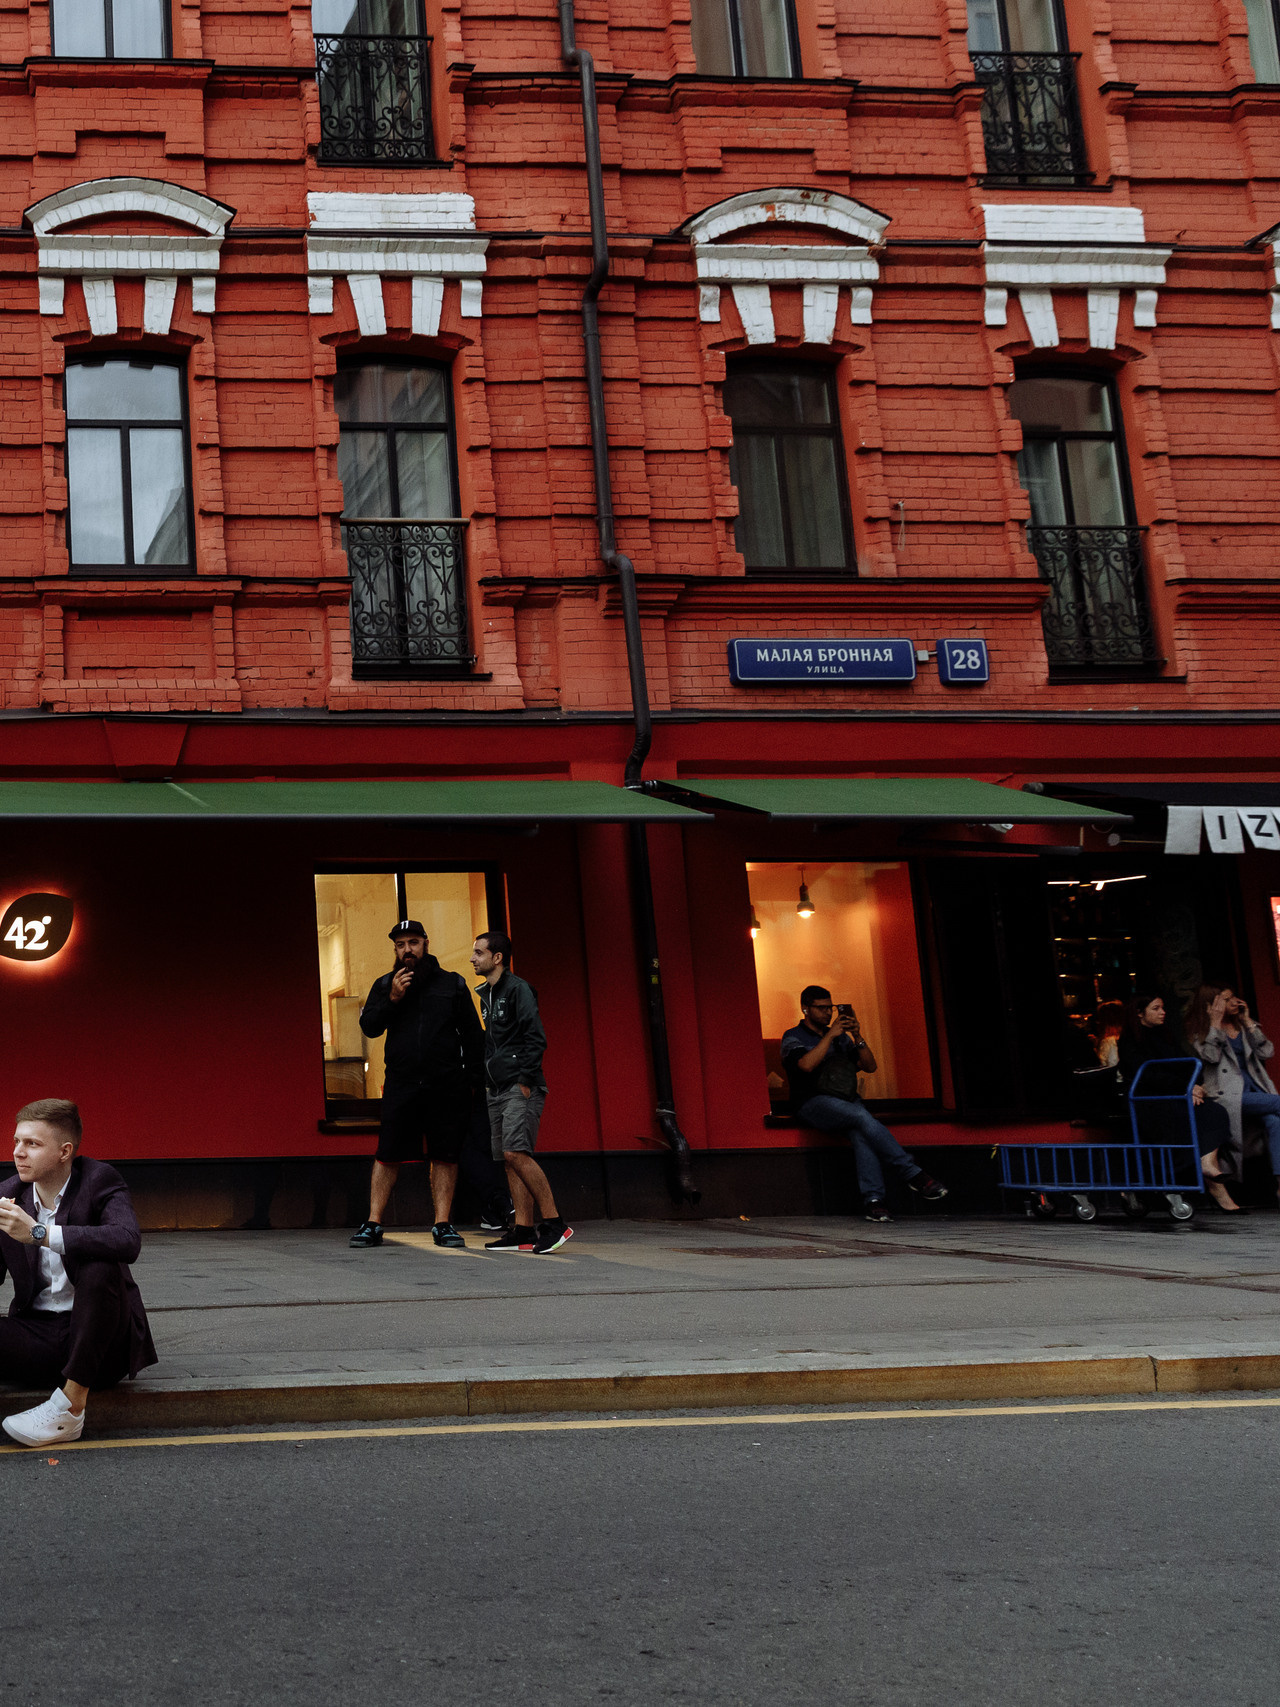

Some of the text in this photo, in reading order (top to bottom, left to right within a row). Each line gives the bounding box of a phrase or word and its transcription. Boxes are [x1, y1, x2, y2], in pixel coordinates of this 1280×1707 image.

[756, 648, 894, 662] МАЛАЯ БРОННАЯ
[952, 649, 981, 670] 28
[806, 666, 845, 674] УЛИЦА
